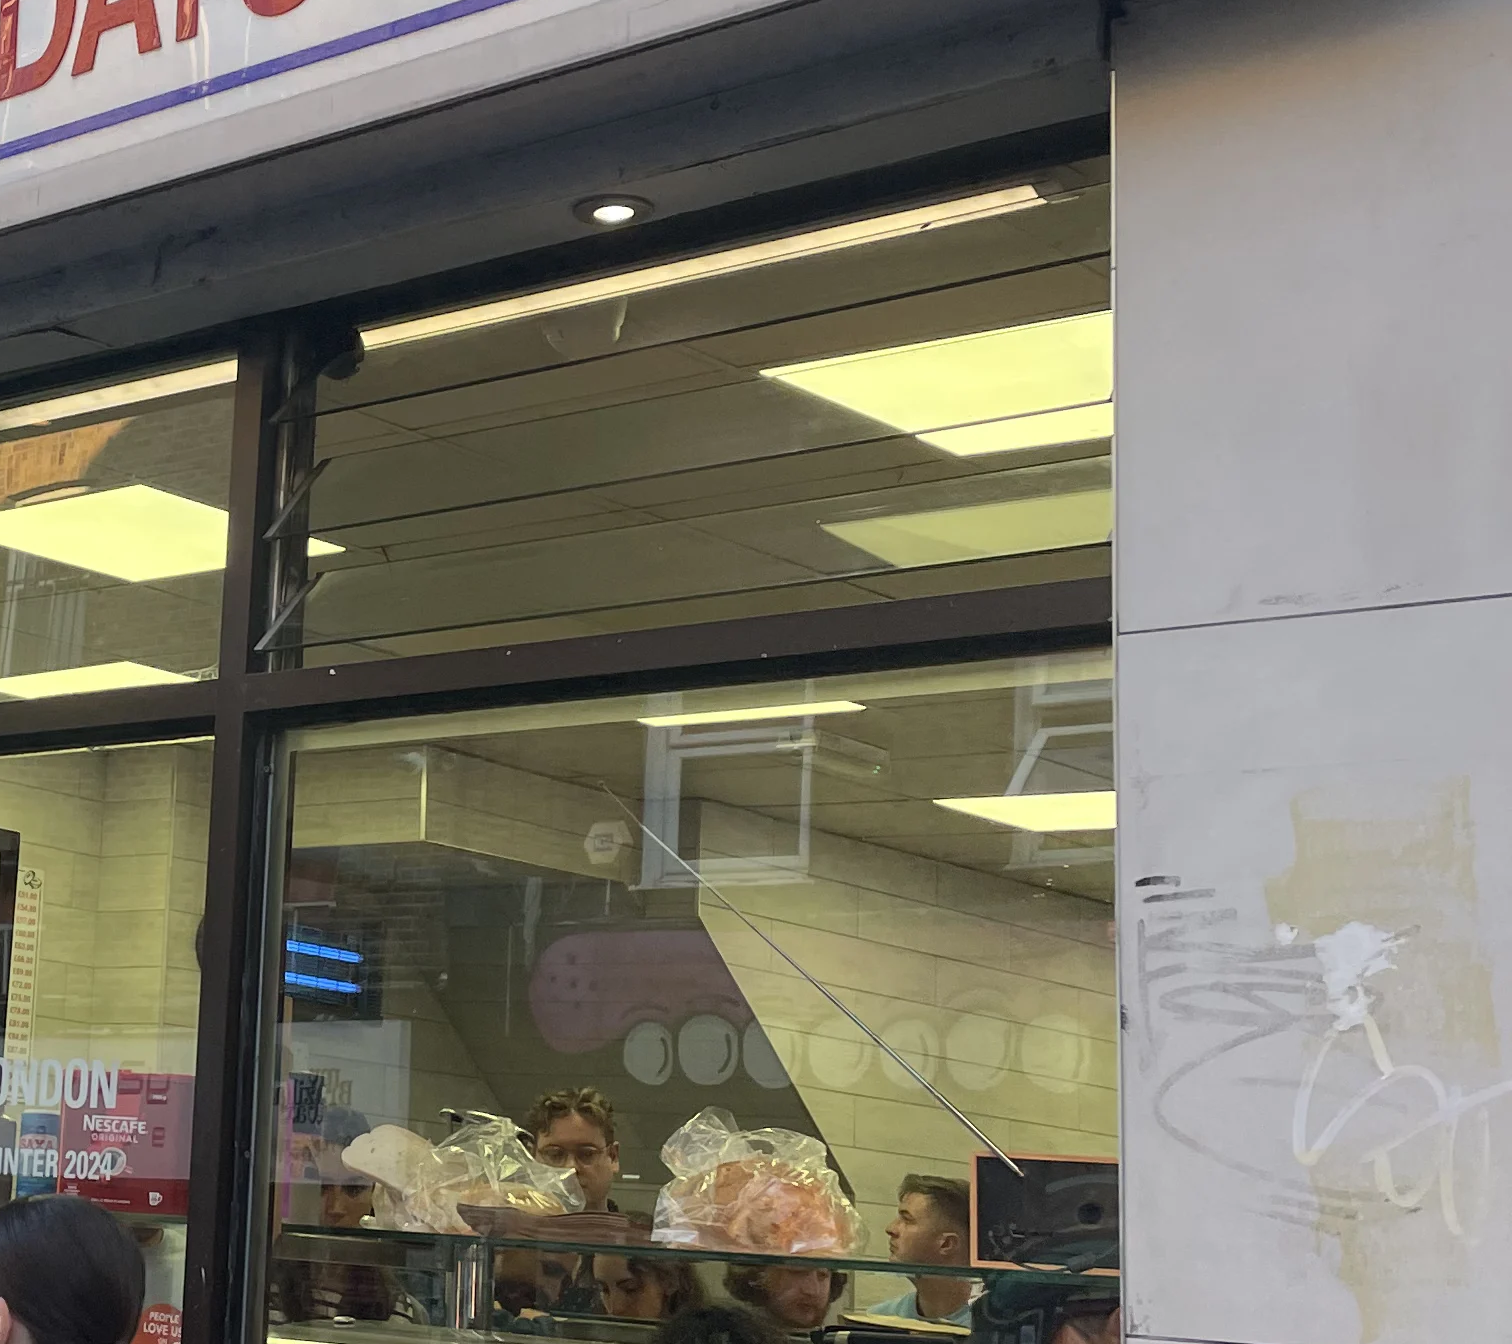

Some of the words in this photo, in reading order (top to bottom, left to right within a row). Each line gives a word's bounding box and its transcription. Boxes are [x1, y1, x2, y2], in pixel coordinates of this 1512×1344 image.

[91, 1133, 139, 1144] ORIGINAL
[63, 1150, 113, 1181] 2024
[149, 1311, 180, 1324] PEOPLE
[143, 1322, 169, 1336] LOVE
